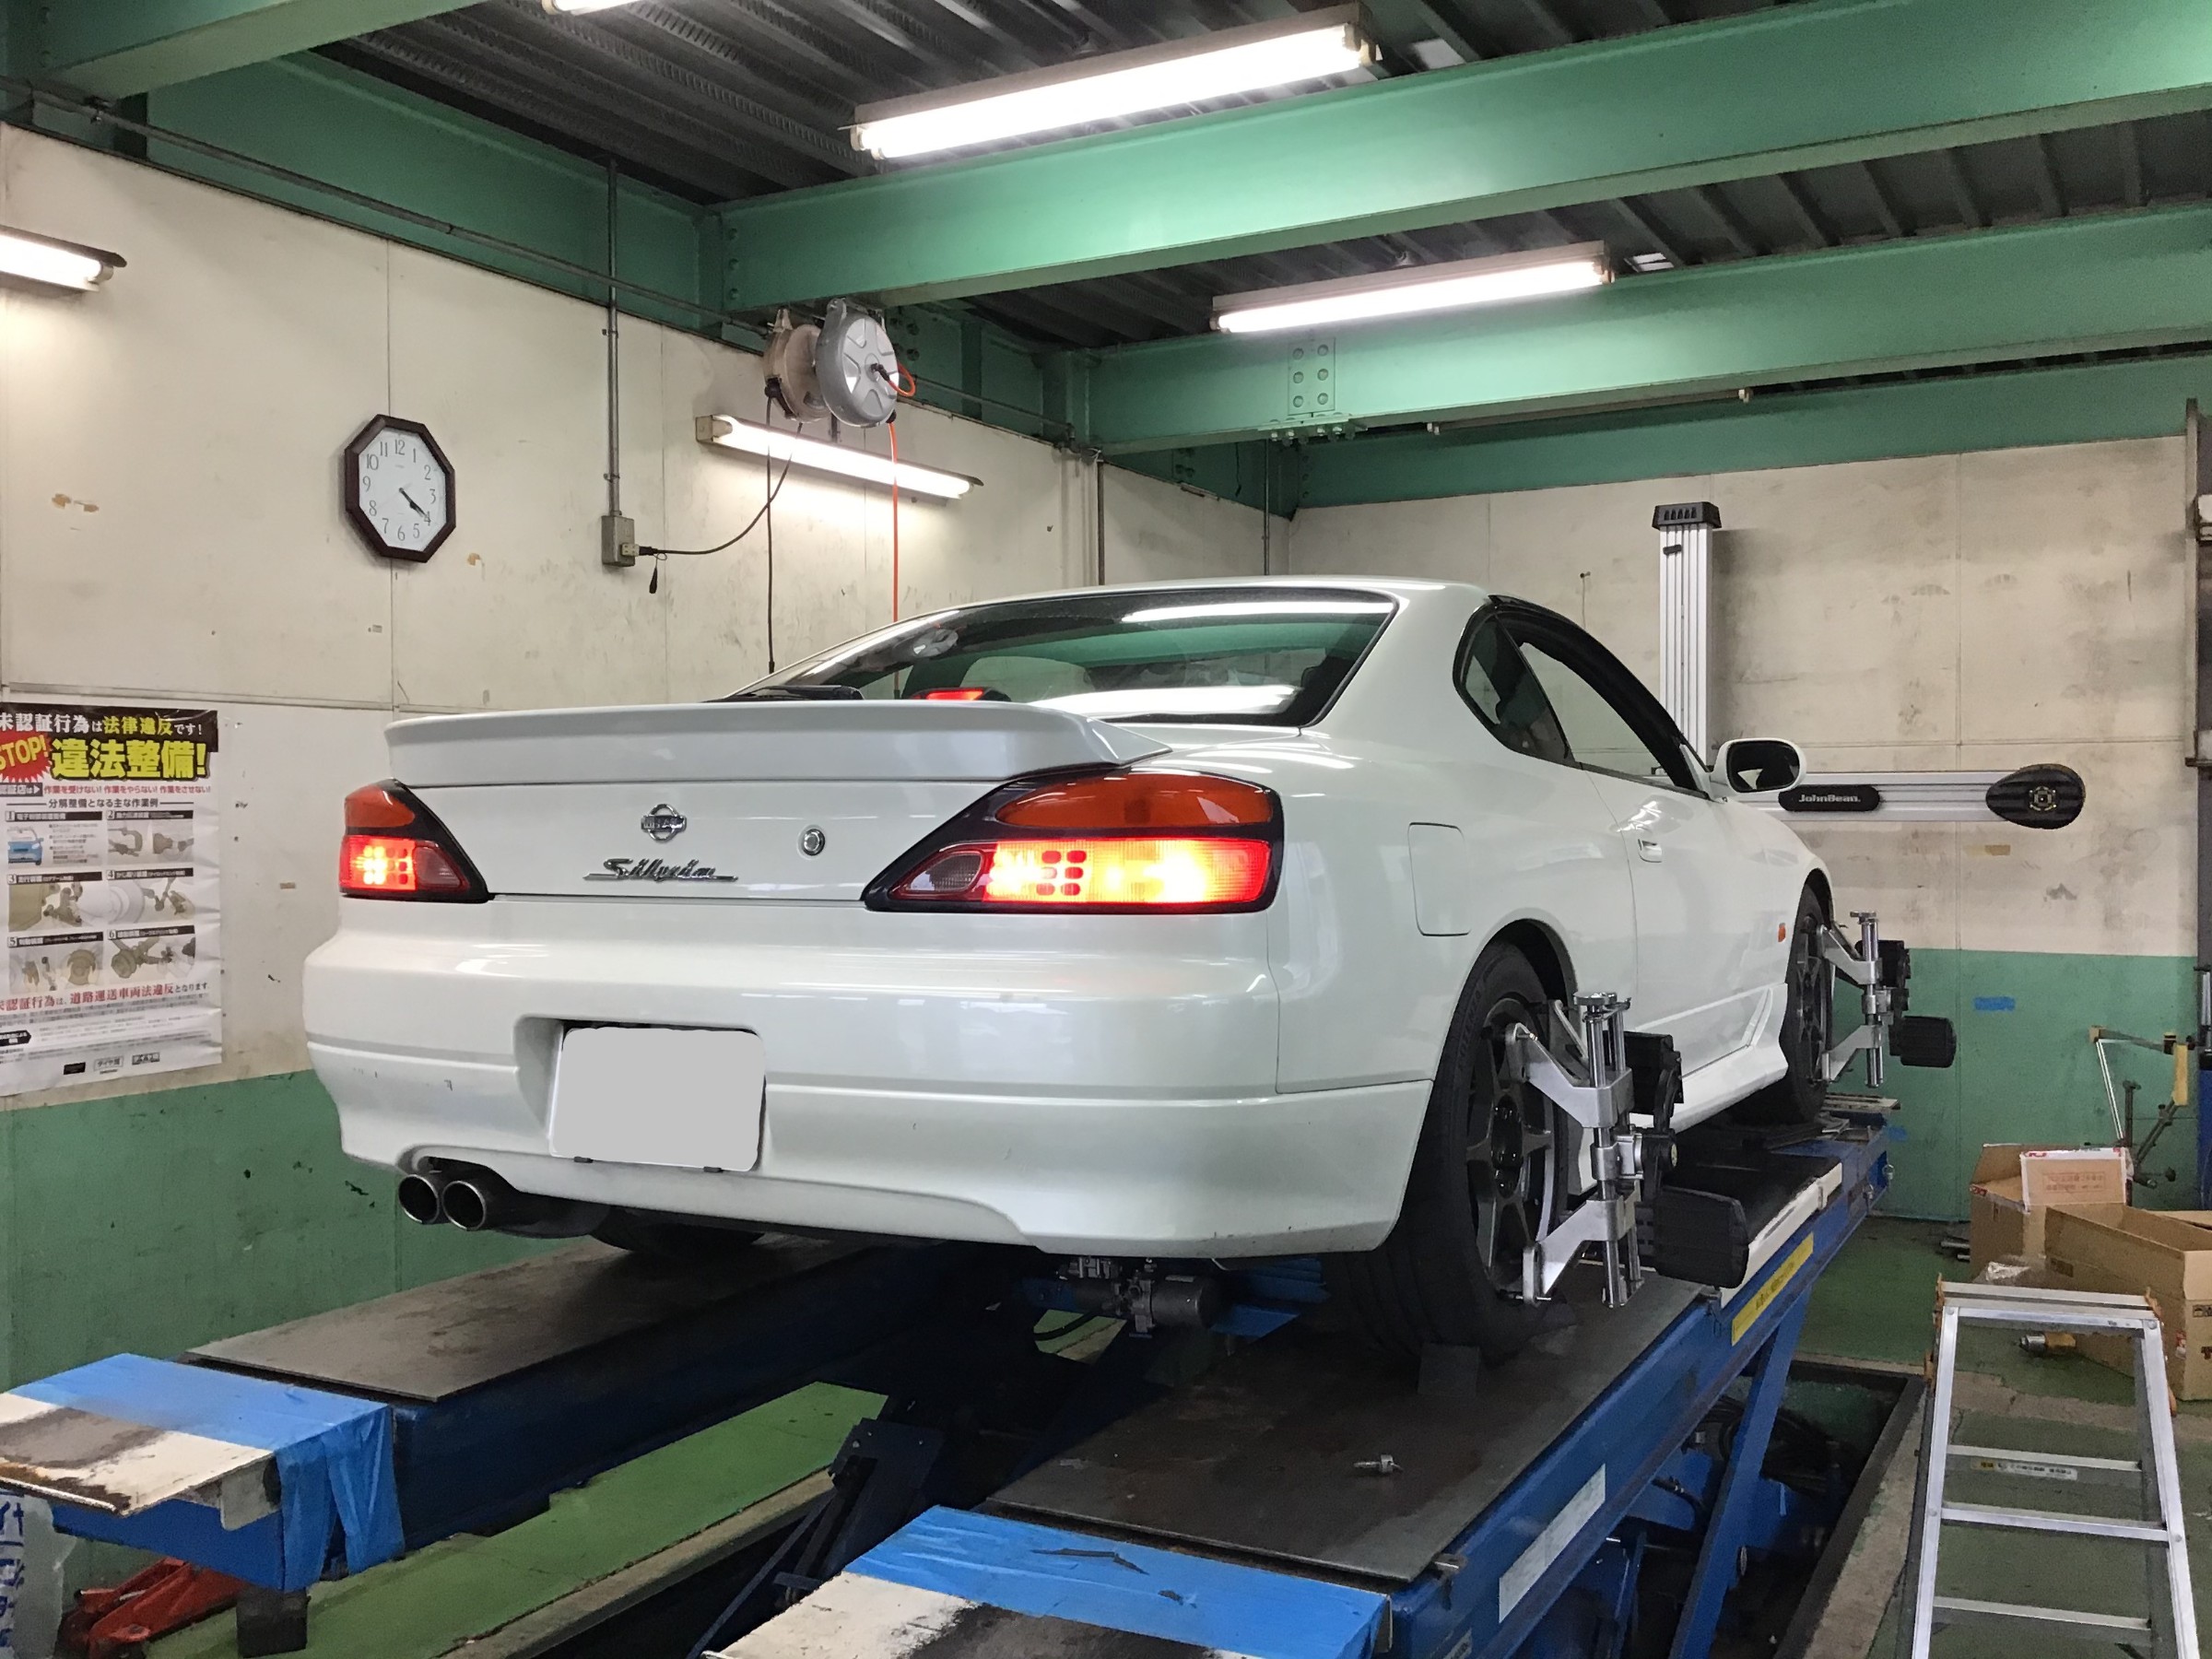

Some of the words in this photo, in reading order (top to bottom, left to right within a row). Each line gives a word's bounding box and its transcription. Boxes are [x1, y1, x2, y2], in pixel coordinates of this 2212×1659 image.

[380, 441, 388, 457] 11
[394, 439, 406, 455] 12
[366, 453, 379, 470] 10
[423, 464, 431, 480] 2
[362, 475, 371, 492] 9
[429, 488, 437, 504] 3
[369, 500, 377, 516] 8
[382, 517, 389, 534] 7
[423, 511, 431, 526] 4
[397, 524, 406, 541] 6
[412, 523, 420, 538] 5
[52, 737, 206, 779] 違法整備!
[49, 798, 159, 808] 分解整備となる主な作業例
